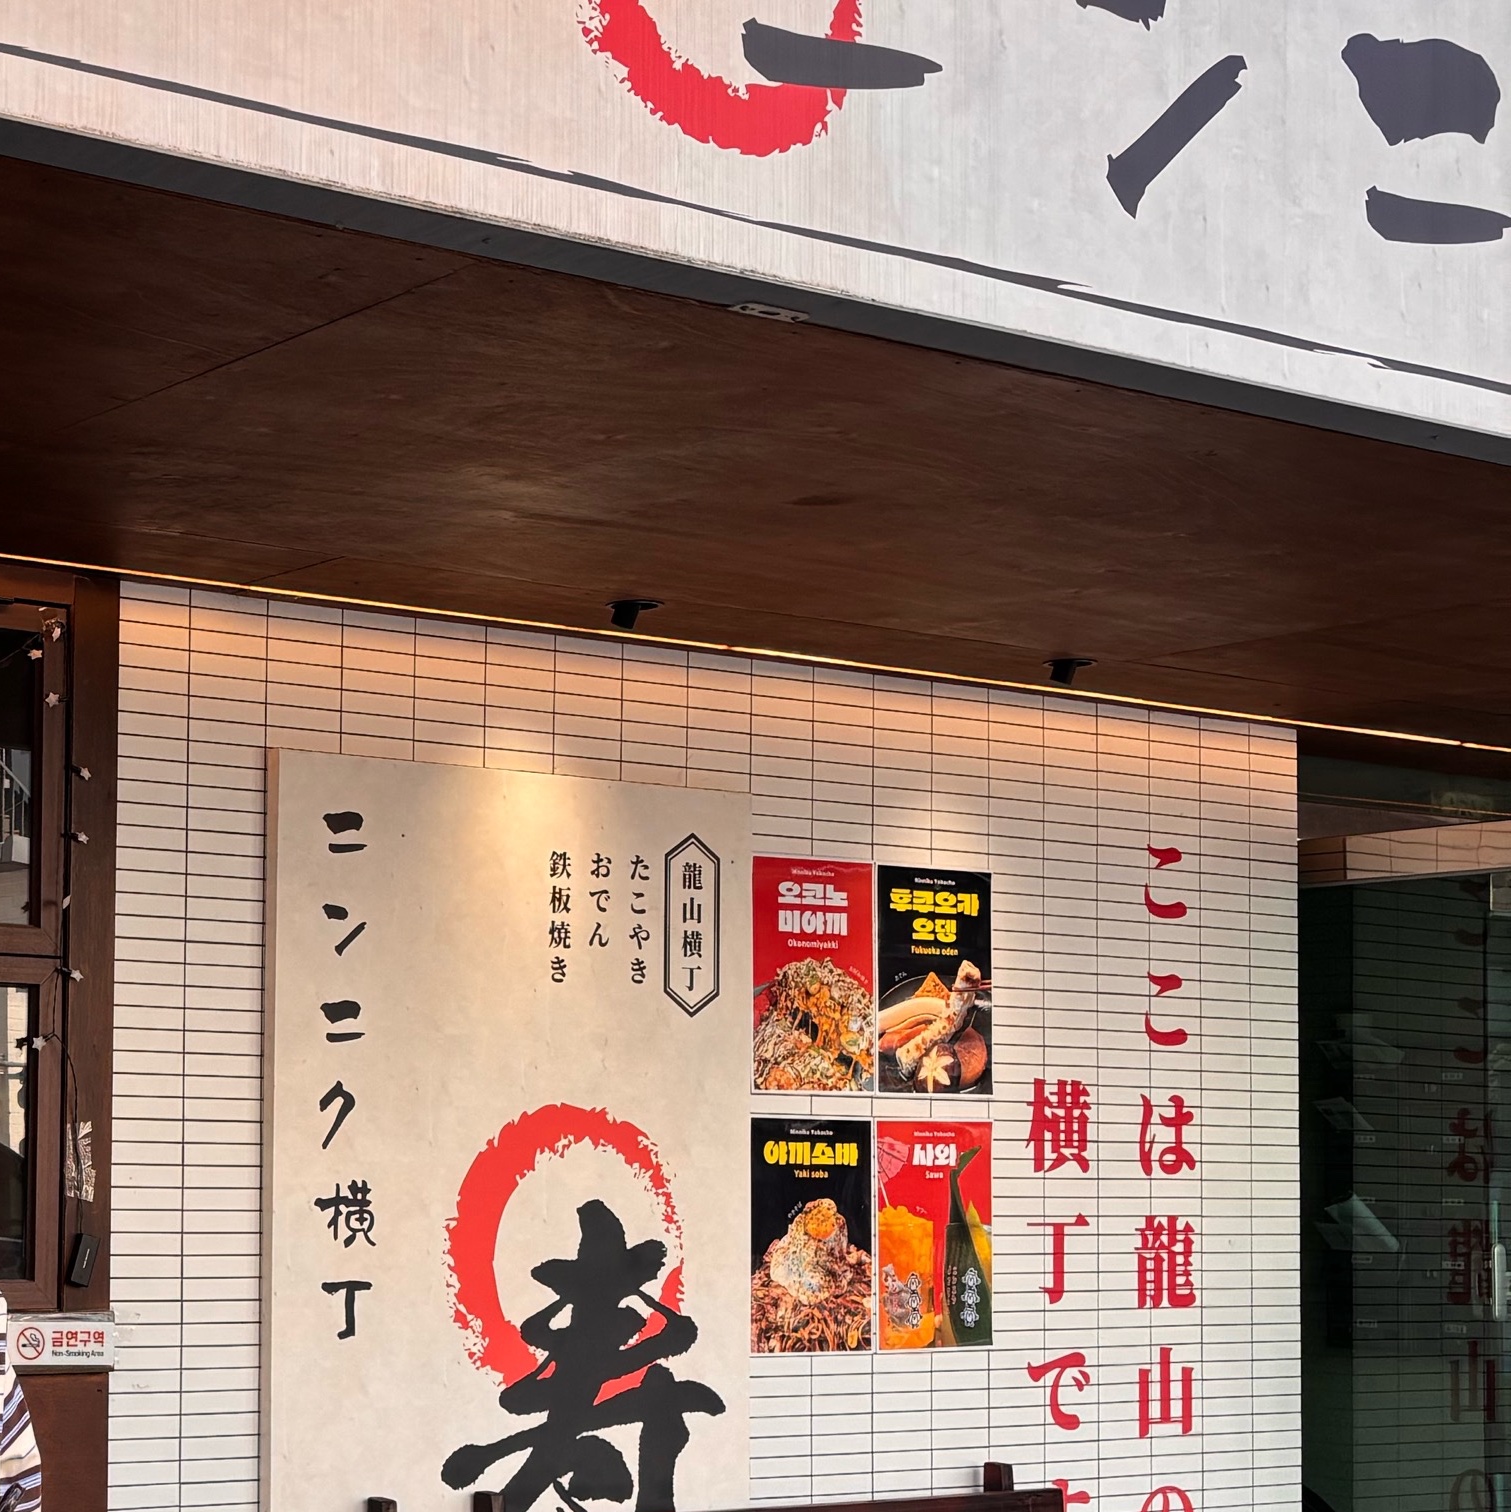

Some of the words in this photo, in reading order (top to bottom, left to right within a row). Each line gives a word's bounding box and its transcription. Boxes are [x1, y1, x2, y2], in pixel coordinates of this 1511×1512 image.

[588, 851, 612, 949] おでん
[778, 881, 848, 907] 오코노
[890, 888, 980, 917] 후쿠오카
[547, 850, 572, 983] 鉄板焼き
[627, 853, 650, 985] たこやき
[679, 860, 706, 992] 龍山横丁
[778, 910, 848, 936] 미야끼
[912, 917, 957, 943] 오뎅
[941, 947, 959, 956] oden
[314, 811, 376, 1340] ニンニク横丁
[763, 1140, 859, 1167] 야끼소바
[912, 1143, 957, 1167] 사와
[794, 1169, 810, 1178] Yaki
[811, 1170, 829, 1179] soba
[925, 1170, 944, 1179] Sawa
[51, 1330, 105, 1348] 금연구역
[51, 1349, 90, 1359] Non-Smoking
